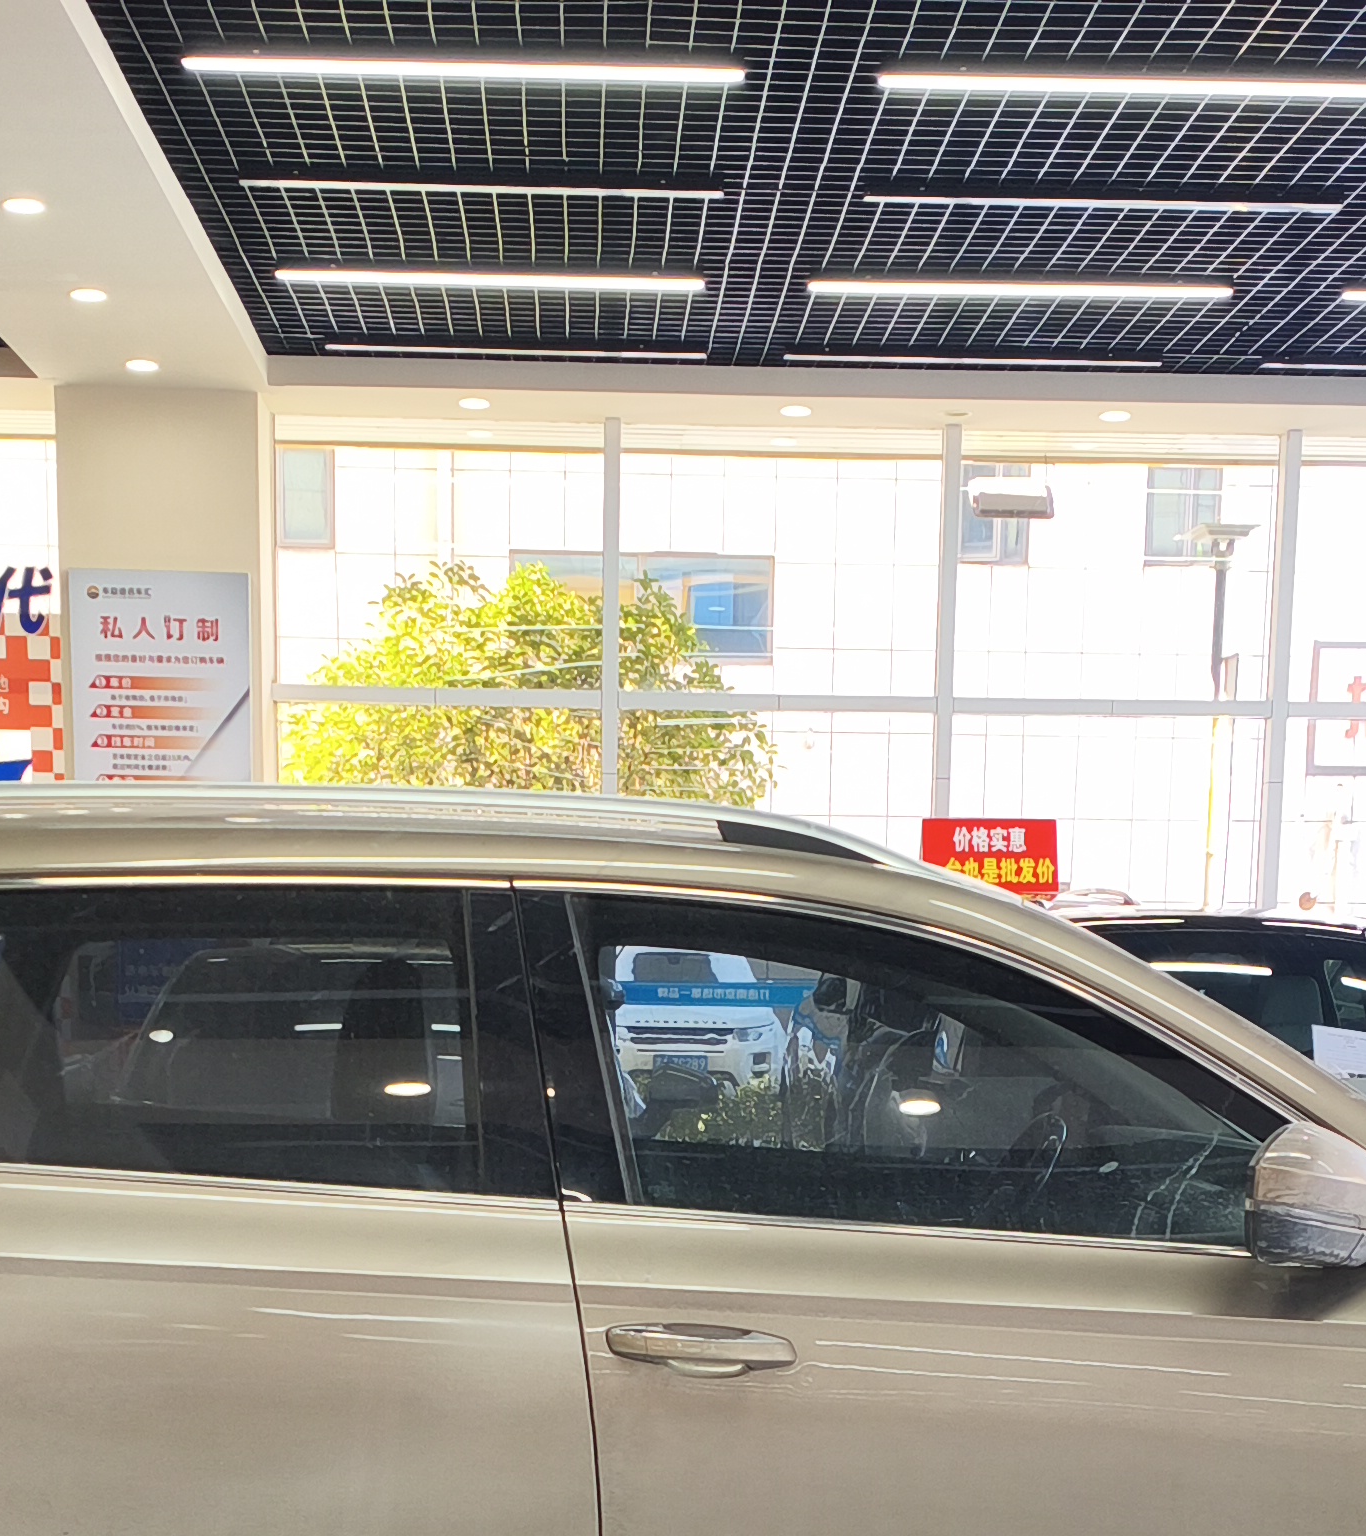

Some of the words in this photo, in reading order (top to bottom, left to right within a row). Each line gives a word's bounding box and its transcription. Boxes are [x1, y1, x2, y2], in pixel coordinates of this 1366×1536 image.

[99, 615, 220, 642] 私人订制
[953, 826, 1026, 852] 价格实惠
